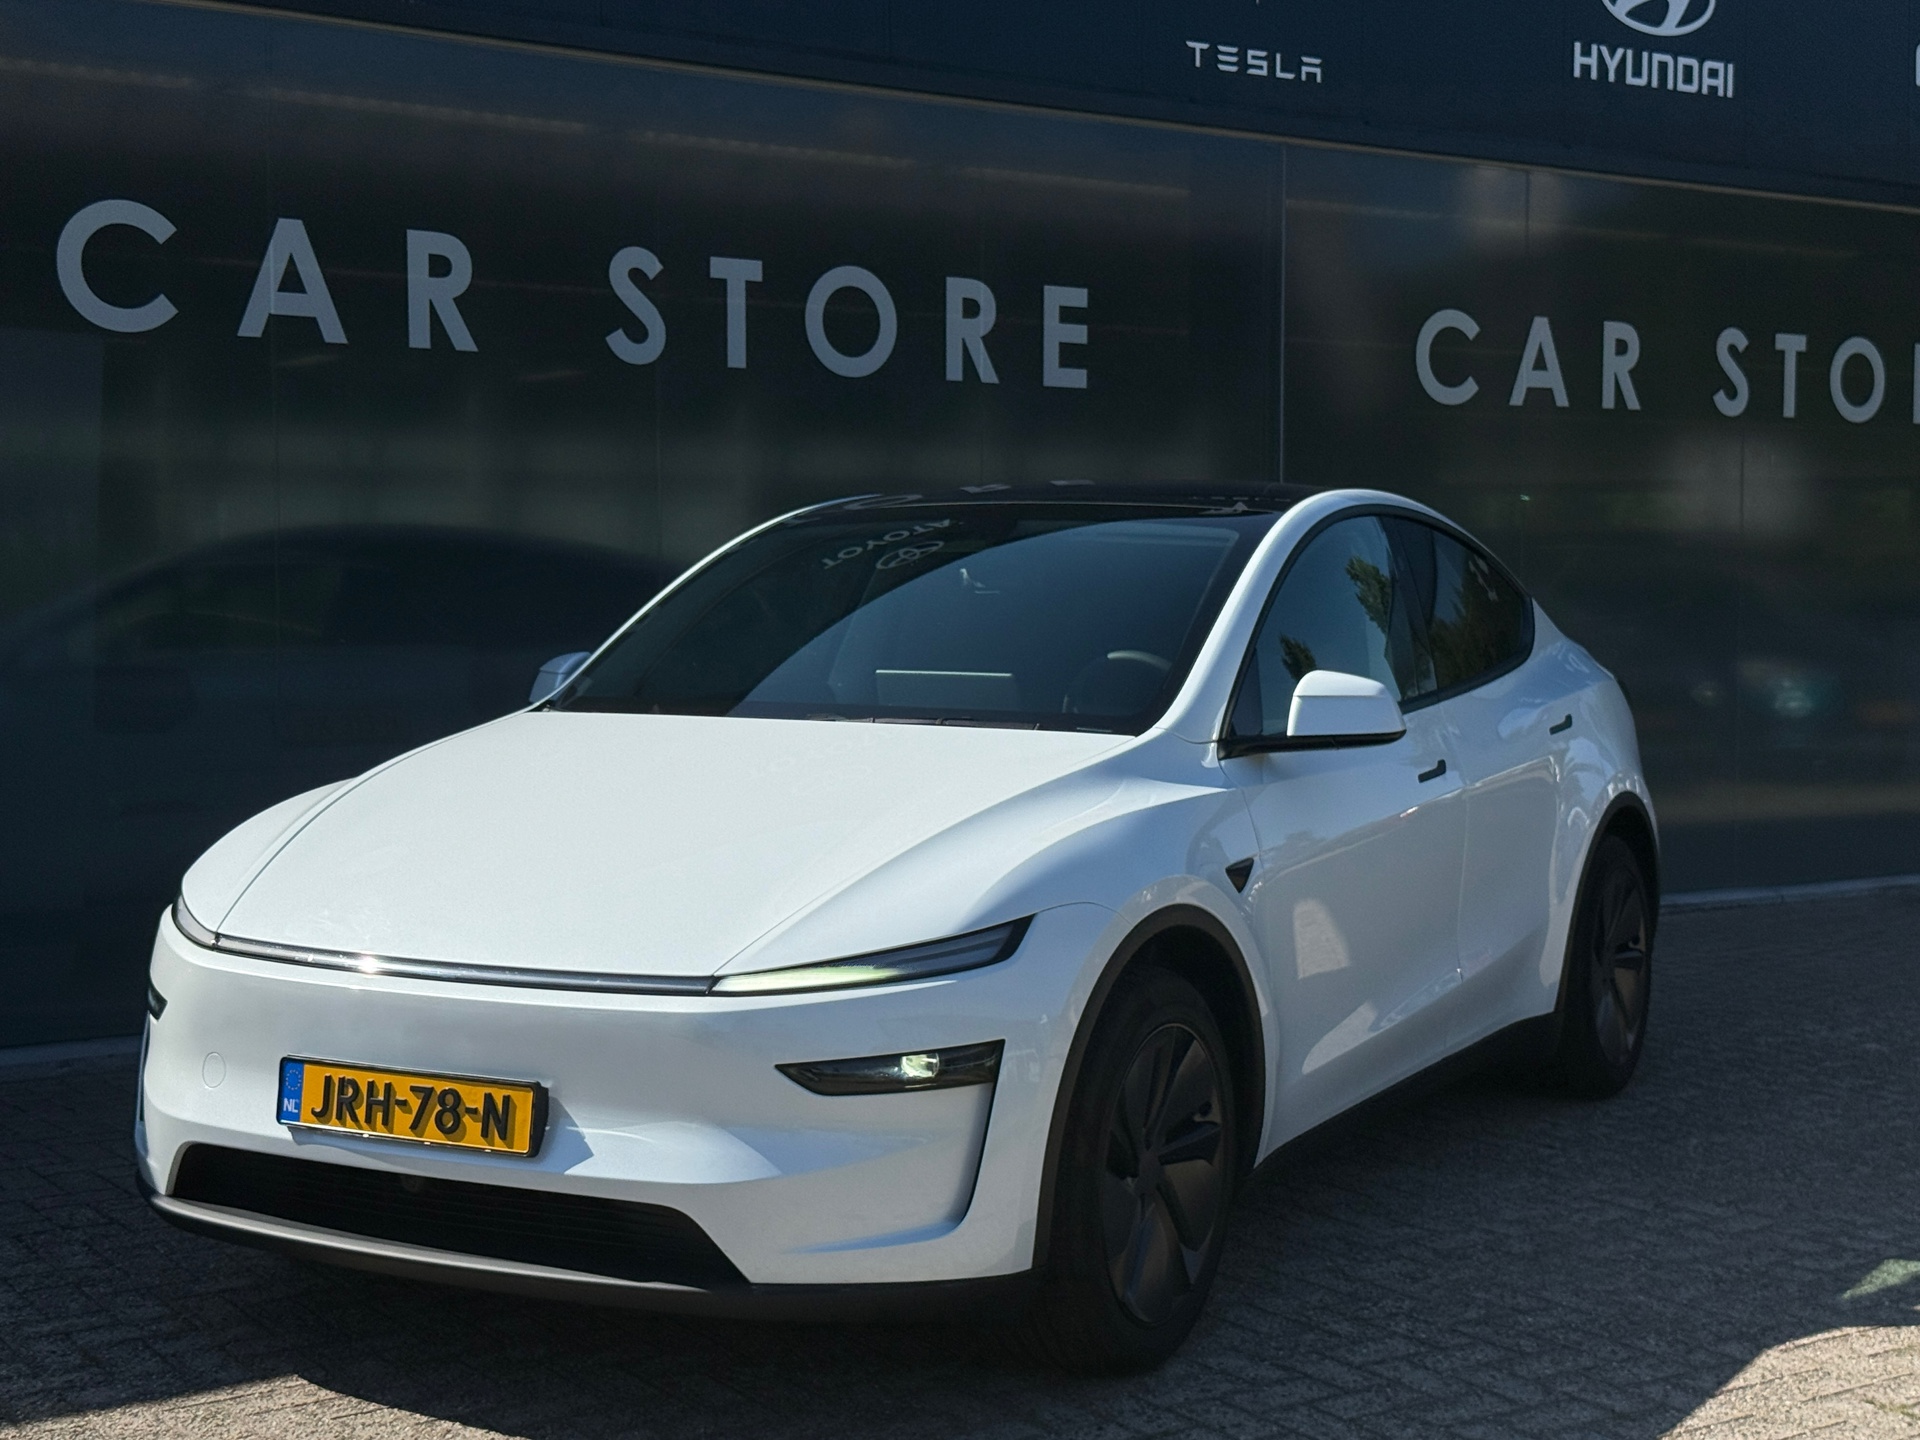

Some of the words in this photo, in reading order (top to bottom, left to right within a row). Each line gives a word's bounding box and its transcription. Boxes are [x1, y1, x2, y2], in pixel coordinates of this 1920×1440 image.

[1185, 40, 1322, 83] TESLA
[1573, 41, 1734, 98] HYUNDAI
[56, 199, 479, 352] CAR
[605, 246, 1088, 389] STORE
[1415, 308, 1641, 411] CAR
[1712, 326, 1920, 424] STO
[283, 1097, 299, 1113] NL
[311, 1073, 511, 1141] JRH-78-N
